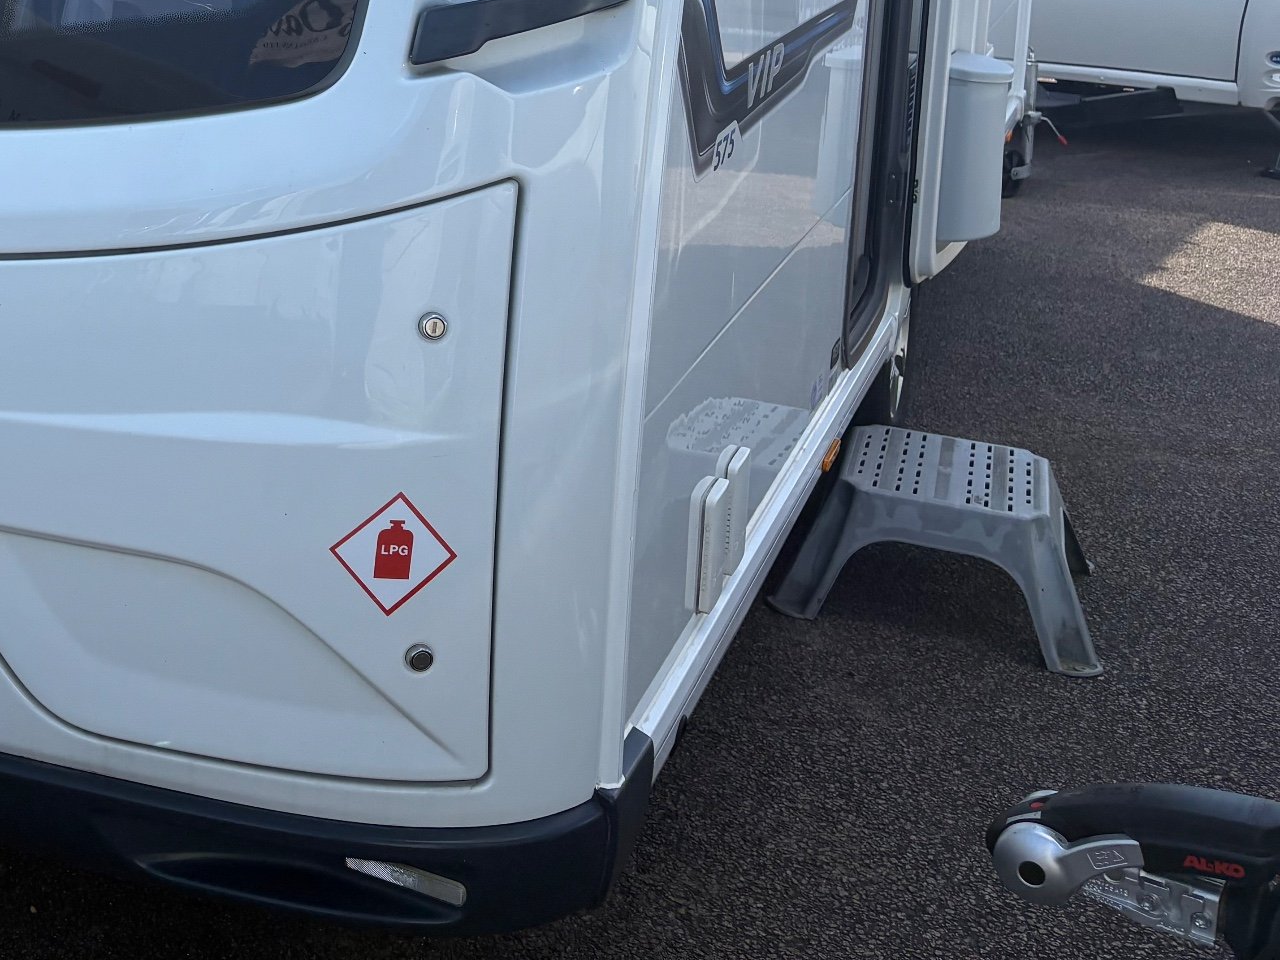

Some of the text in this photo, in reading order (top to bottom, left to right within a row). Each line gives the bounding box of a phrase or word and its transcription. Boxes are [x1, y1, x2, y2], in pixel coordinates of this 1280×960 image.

[747, 42, 785, 109] VIP
[713, 126, 737, 172] 575
[380, 544, 409, 556] LPG
[1182, 854, 1246, 879] AL-KO
